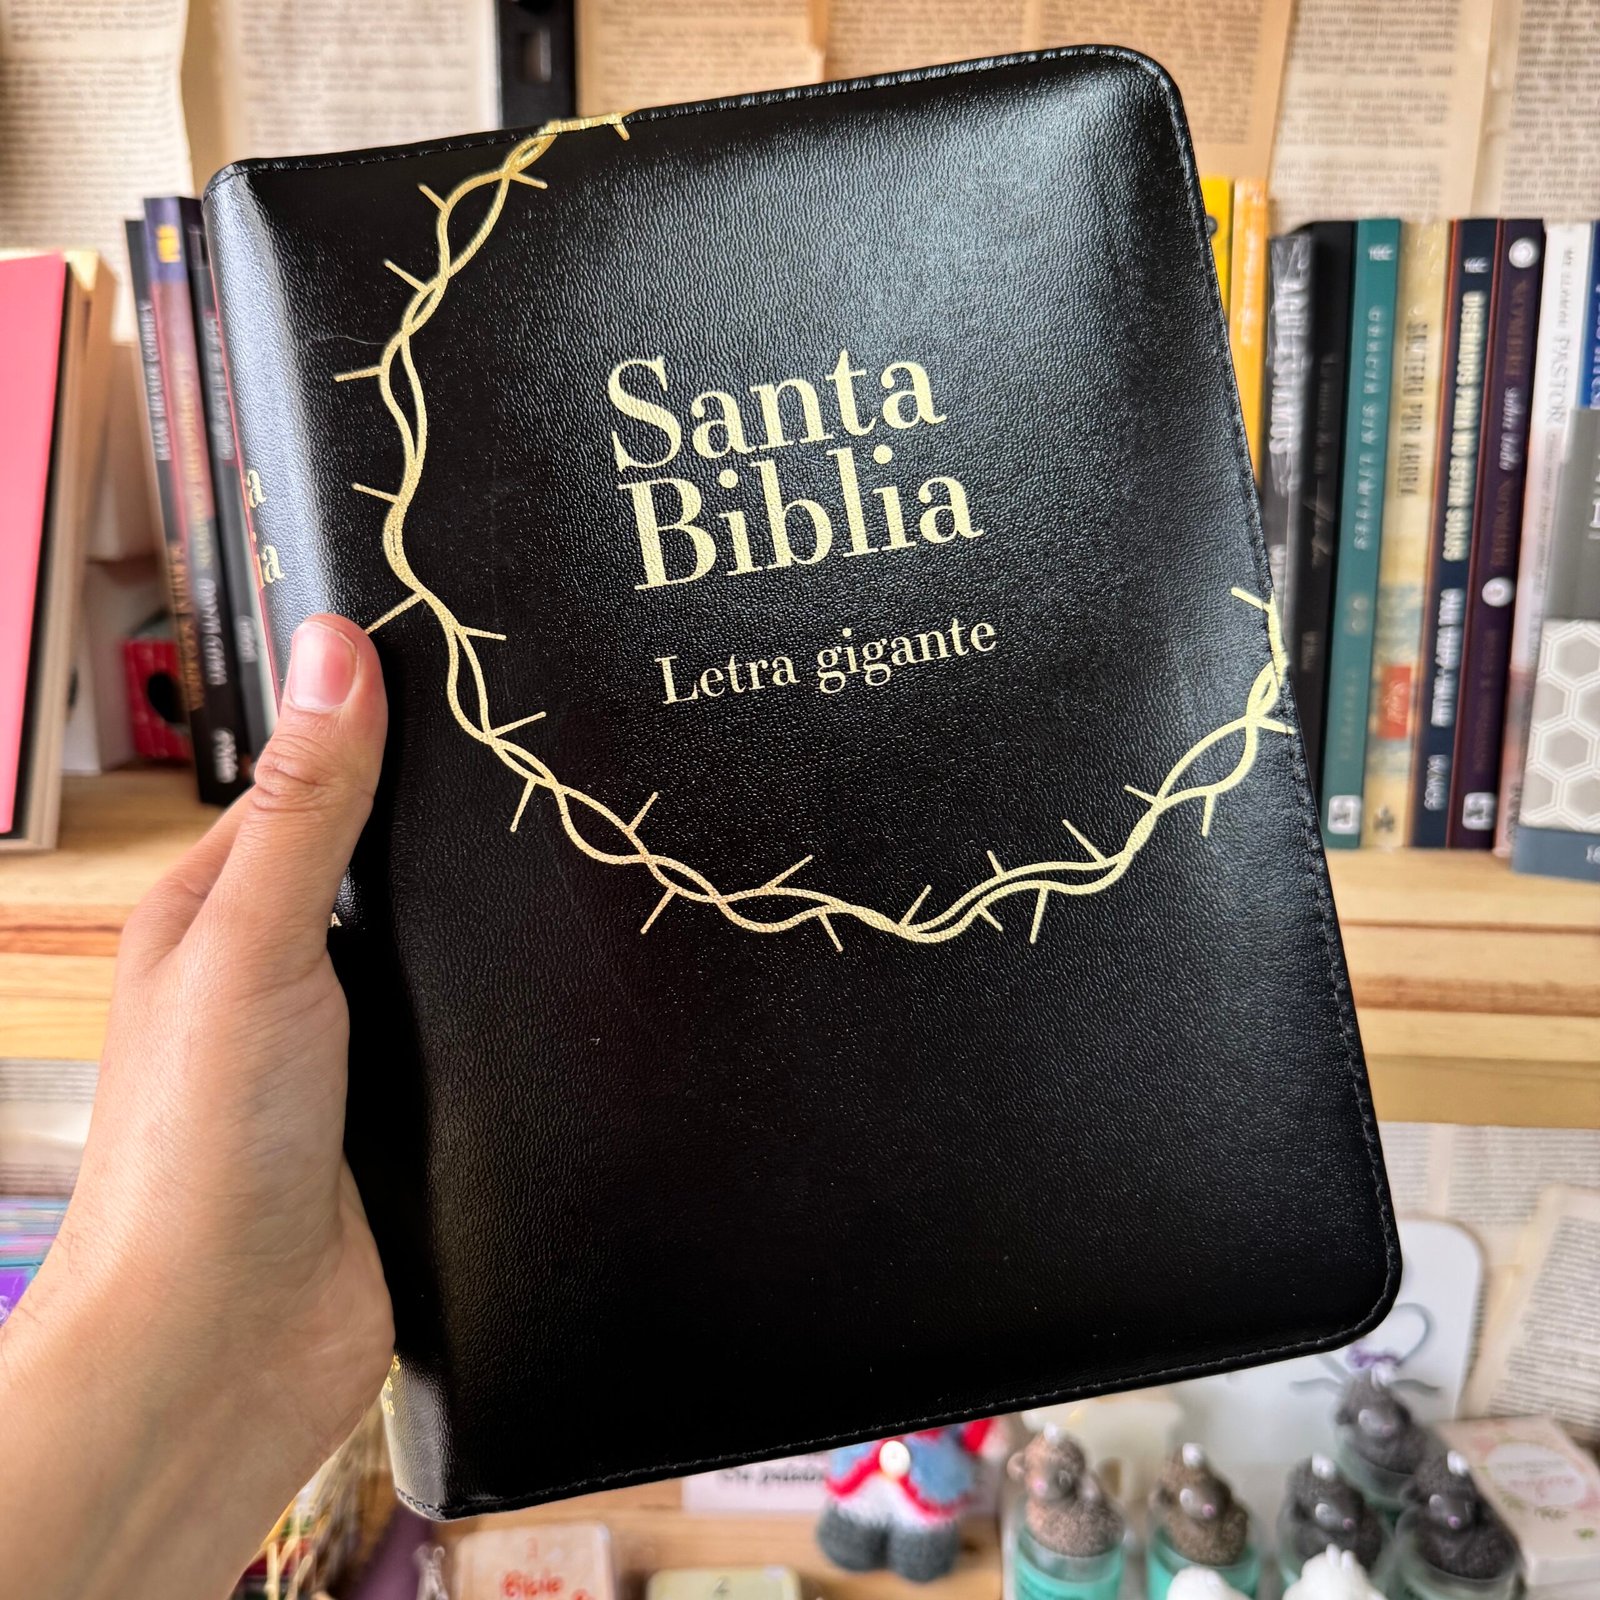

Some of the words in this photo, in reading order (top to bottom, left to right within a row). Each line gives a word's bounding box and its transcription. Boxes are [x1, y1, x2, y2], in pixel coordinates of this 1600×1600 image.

[607, 348, 947, 472] Santa
[617, 445, 984, 590] Biblia
[655, 655, 800, 705] Letra
[816, 618, 997, 694] gigante
